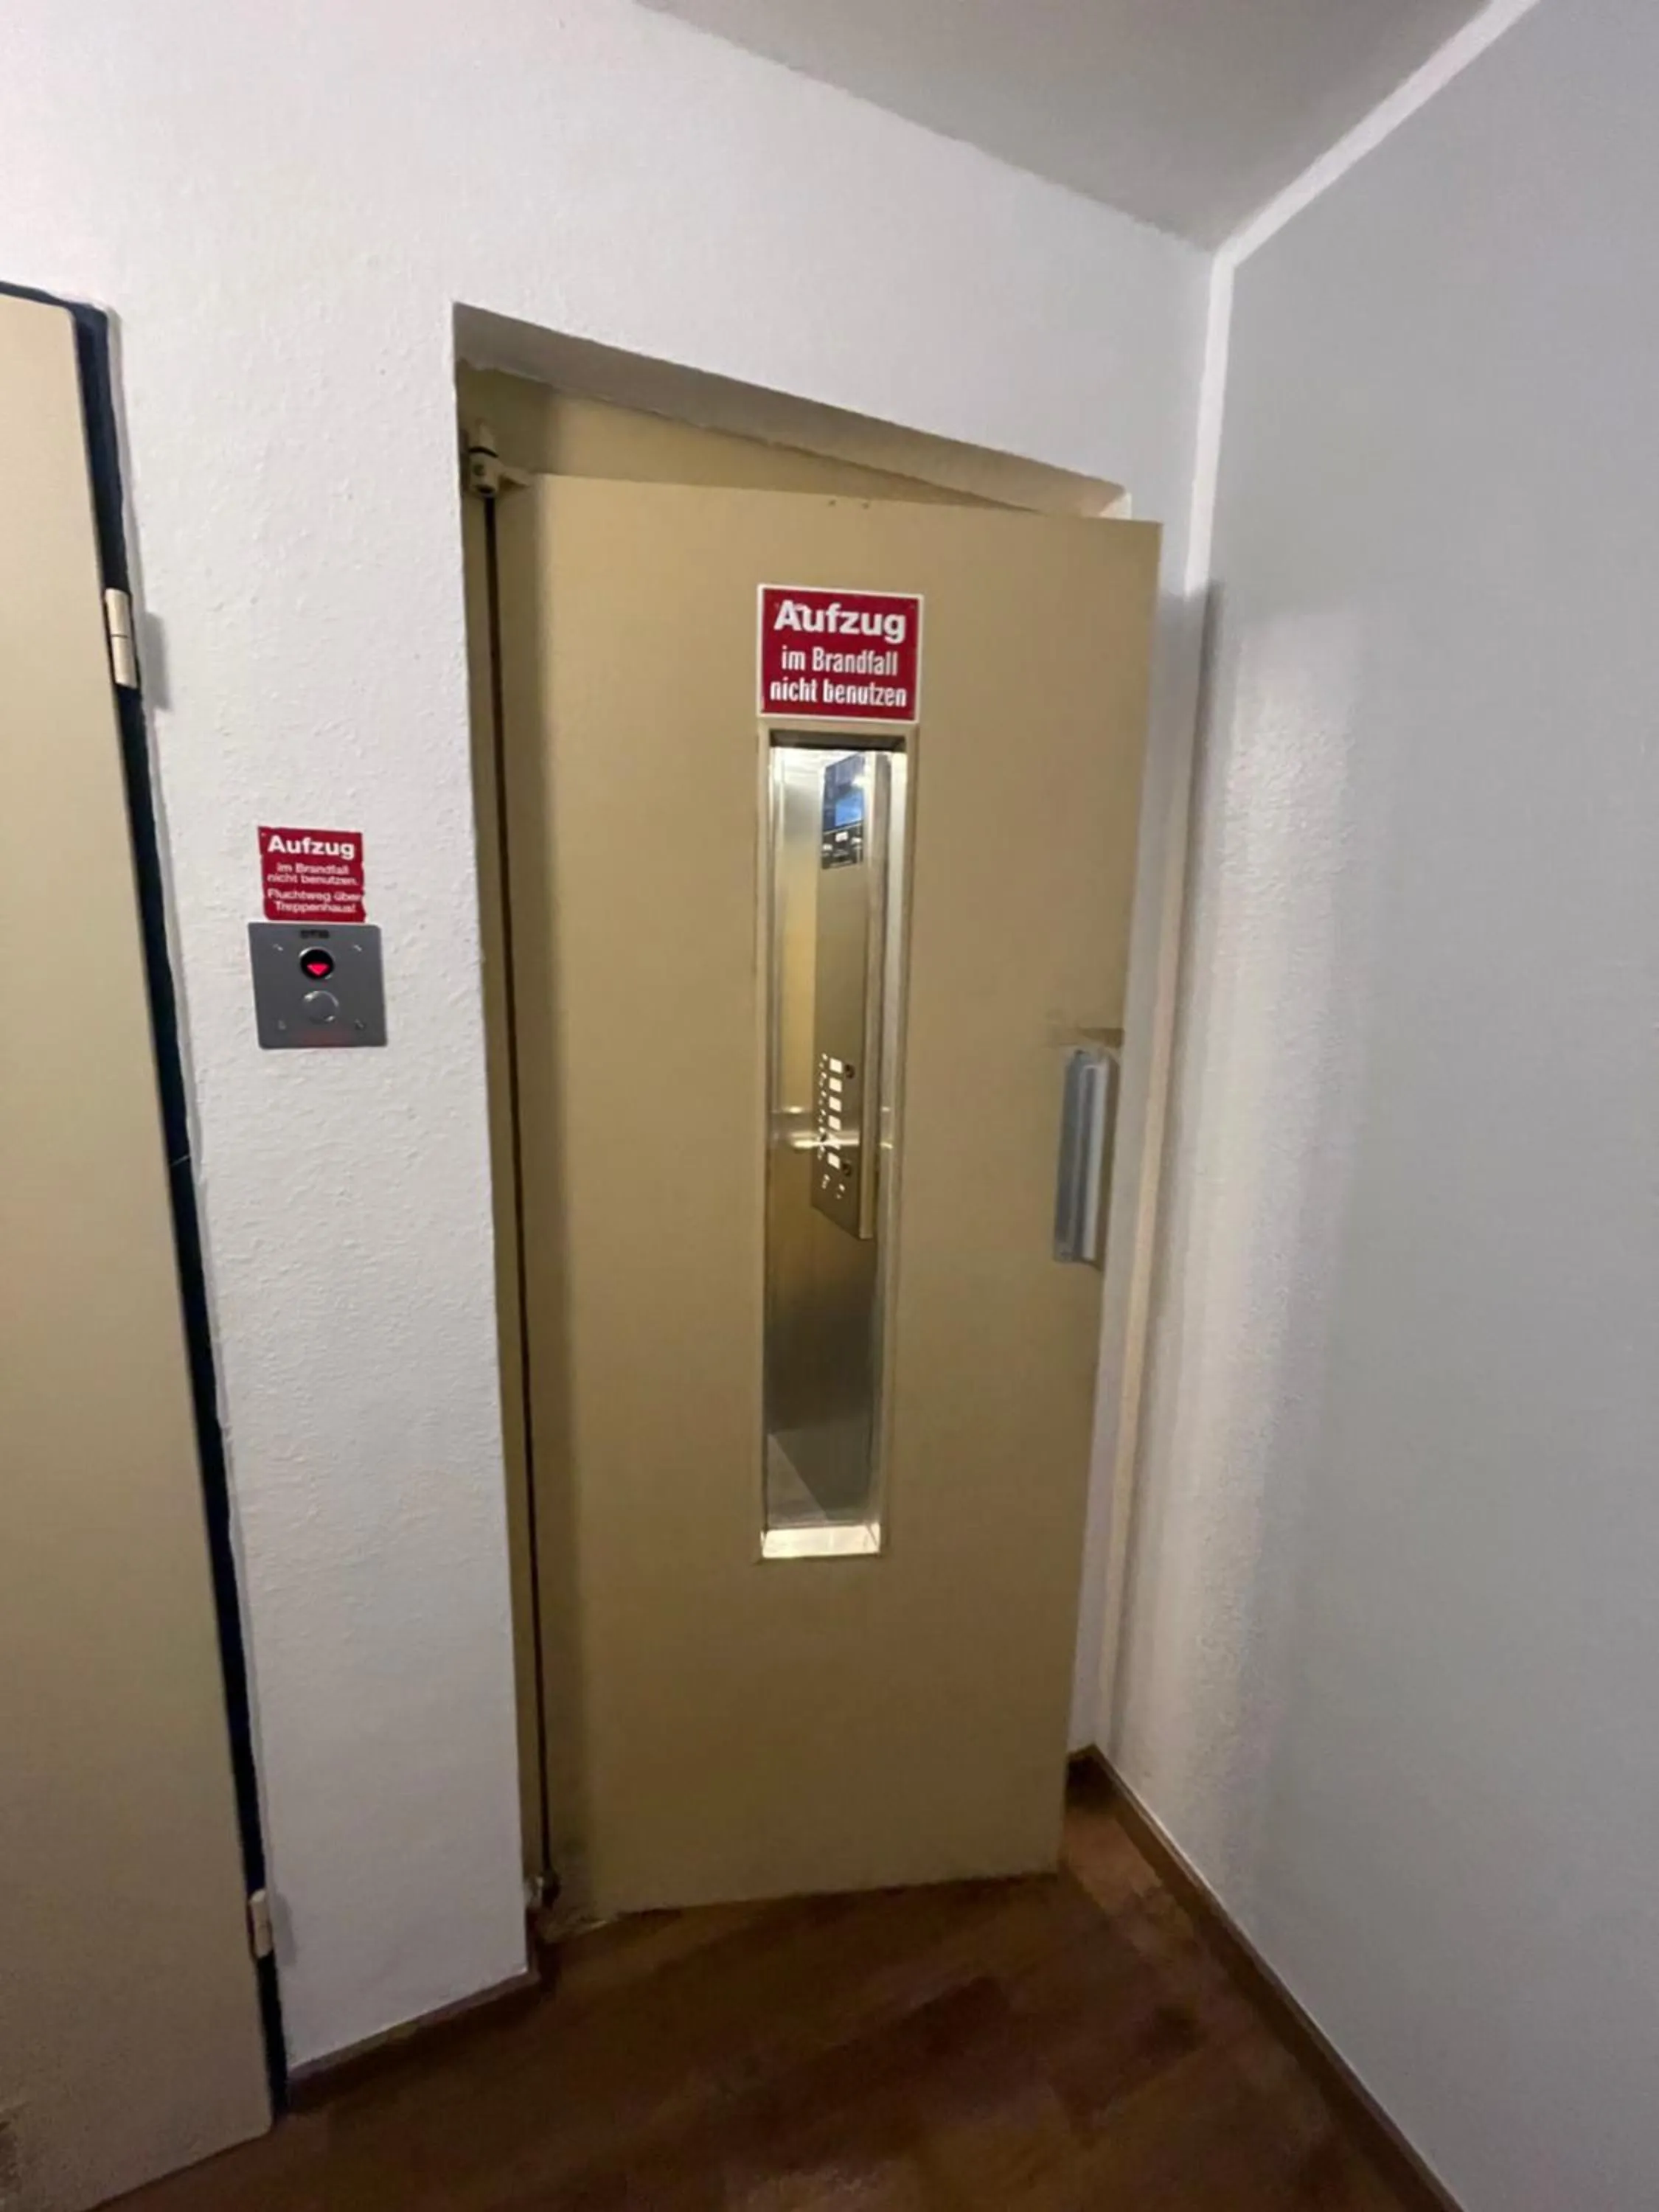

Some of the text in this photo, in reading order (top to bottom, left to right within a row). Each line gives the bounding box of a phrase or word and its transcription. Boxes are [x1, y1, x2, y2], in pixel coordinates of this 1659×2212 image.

[773, 599, 906, 644] Aufzug
[782, 644, 898, 676] im Brandfall
[770, 676, 907, 708] nicht benutzen
[267, 835, 355, 860] Aufzug
[267, 873, 298, 883] nicht
[276, 863, 349, 874] im Brandfall
[267, 888, 331, 903] Fluchtweg
